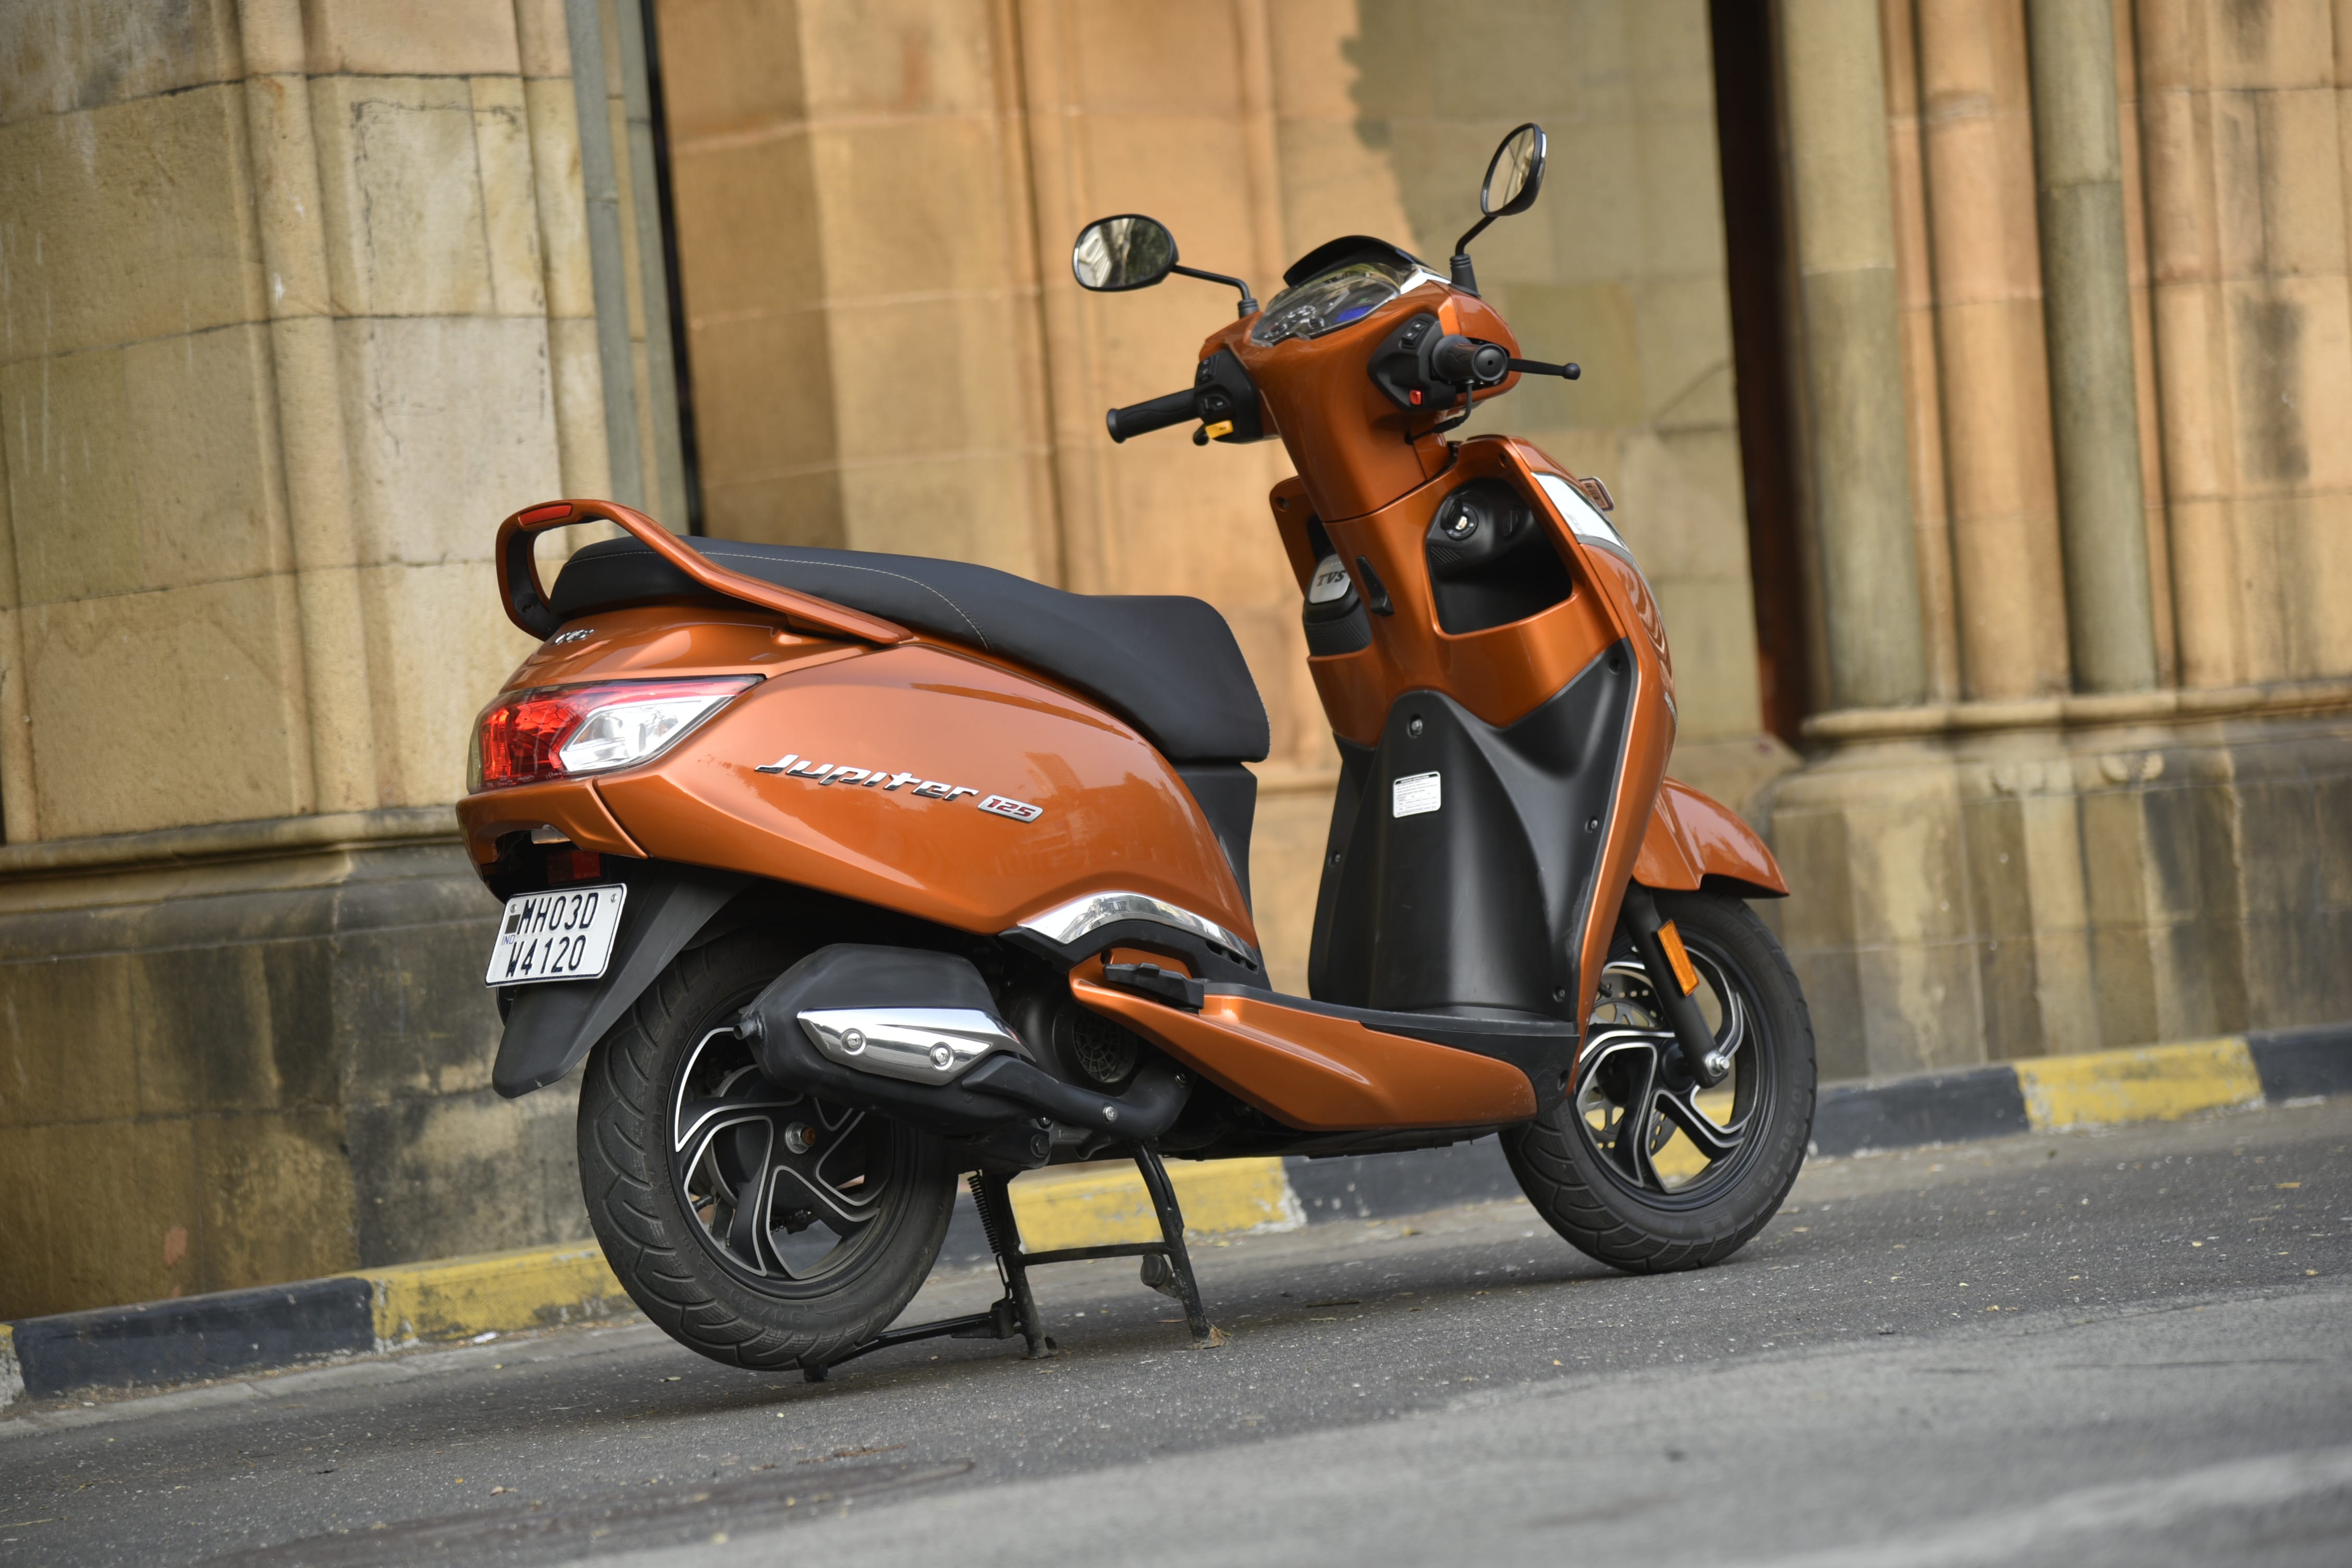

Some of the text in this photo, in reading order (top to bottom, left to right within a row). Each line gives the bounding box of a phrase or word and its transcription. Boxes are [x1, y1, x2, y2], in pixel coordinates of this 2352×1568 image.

[1316, 570, 1347, 587] TVS
[754, 754, 1036, 818] Jupiter 125
[517, 892, 599, 935] MH03D
[501, 934, 516, 946] IND
[505, 934, 586, 978] W4120
[1761, 1070, 1805, 1187] 90/90-12
[697, 1259, 806, 1326] 90/90-12
